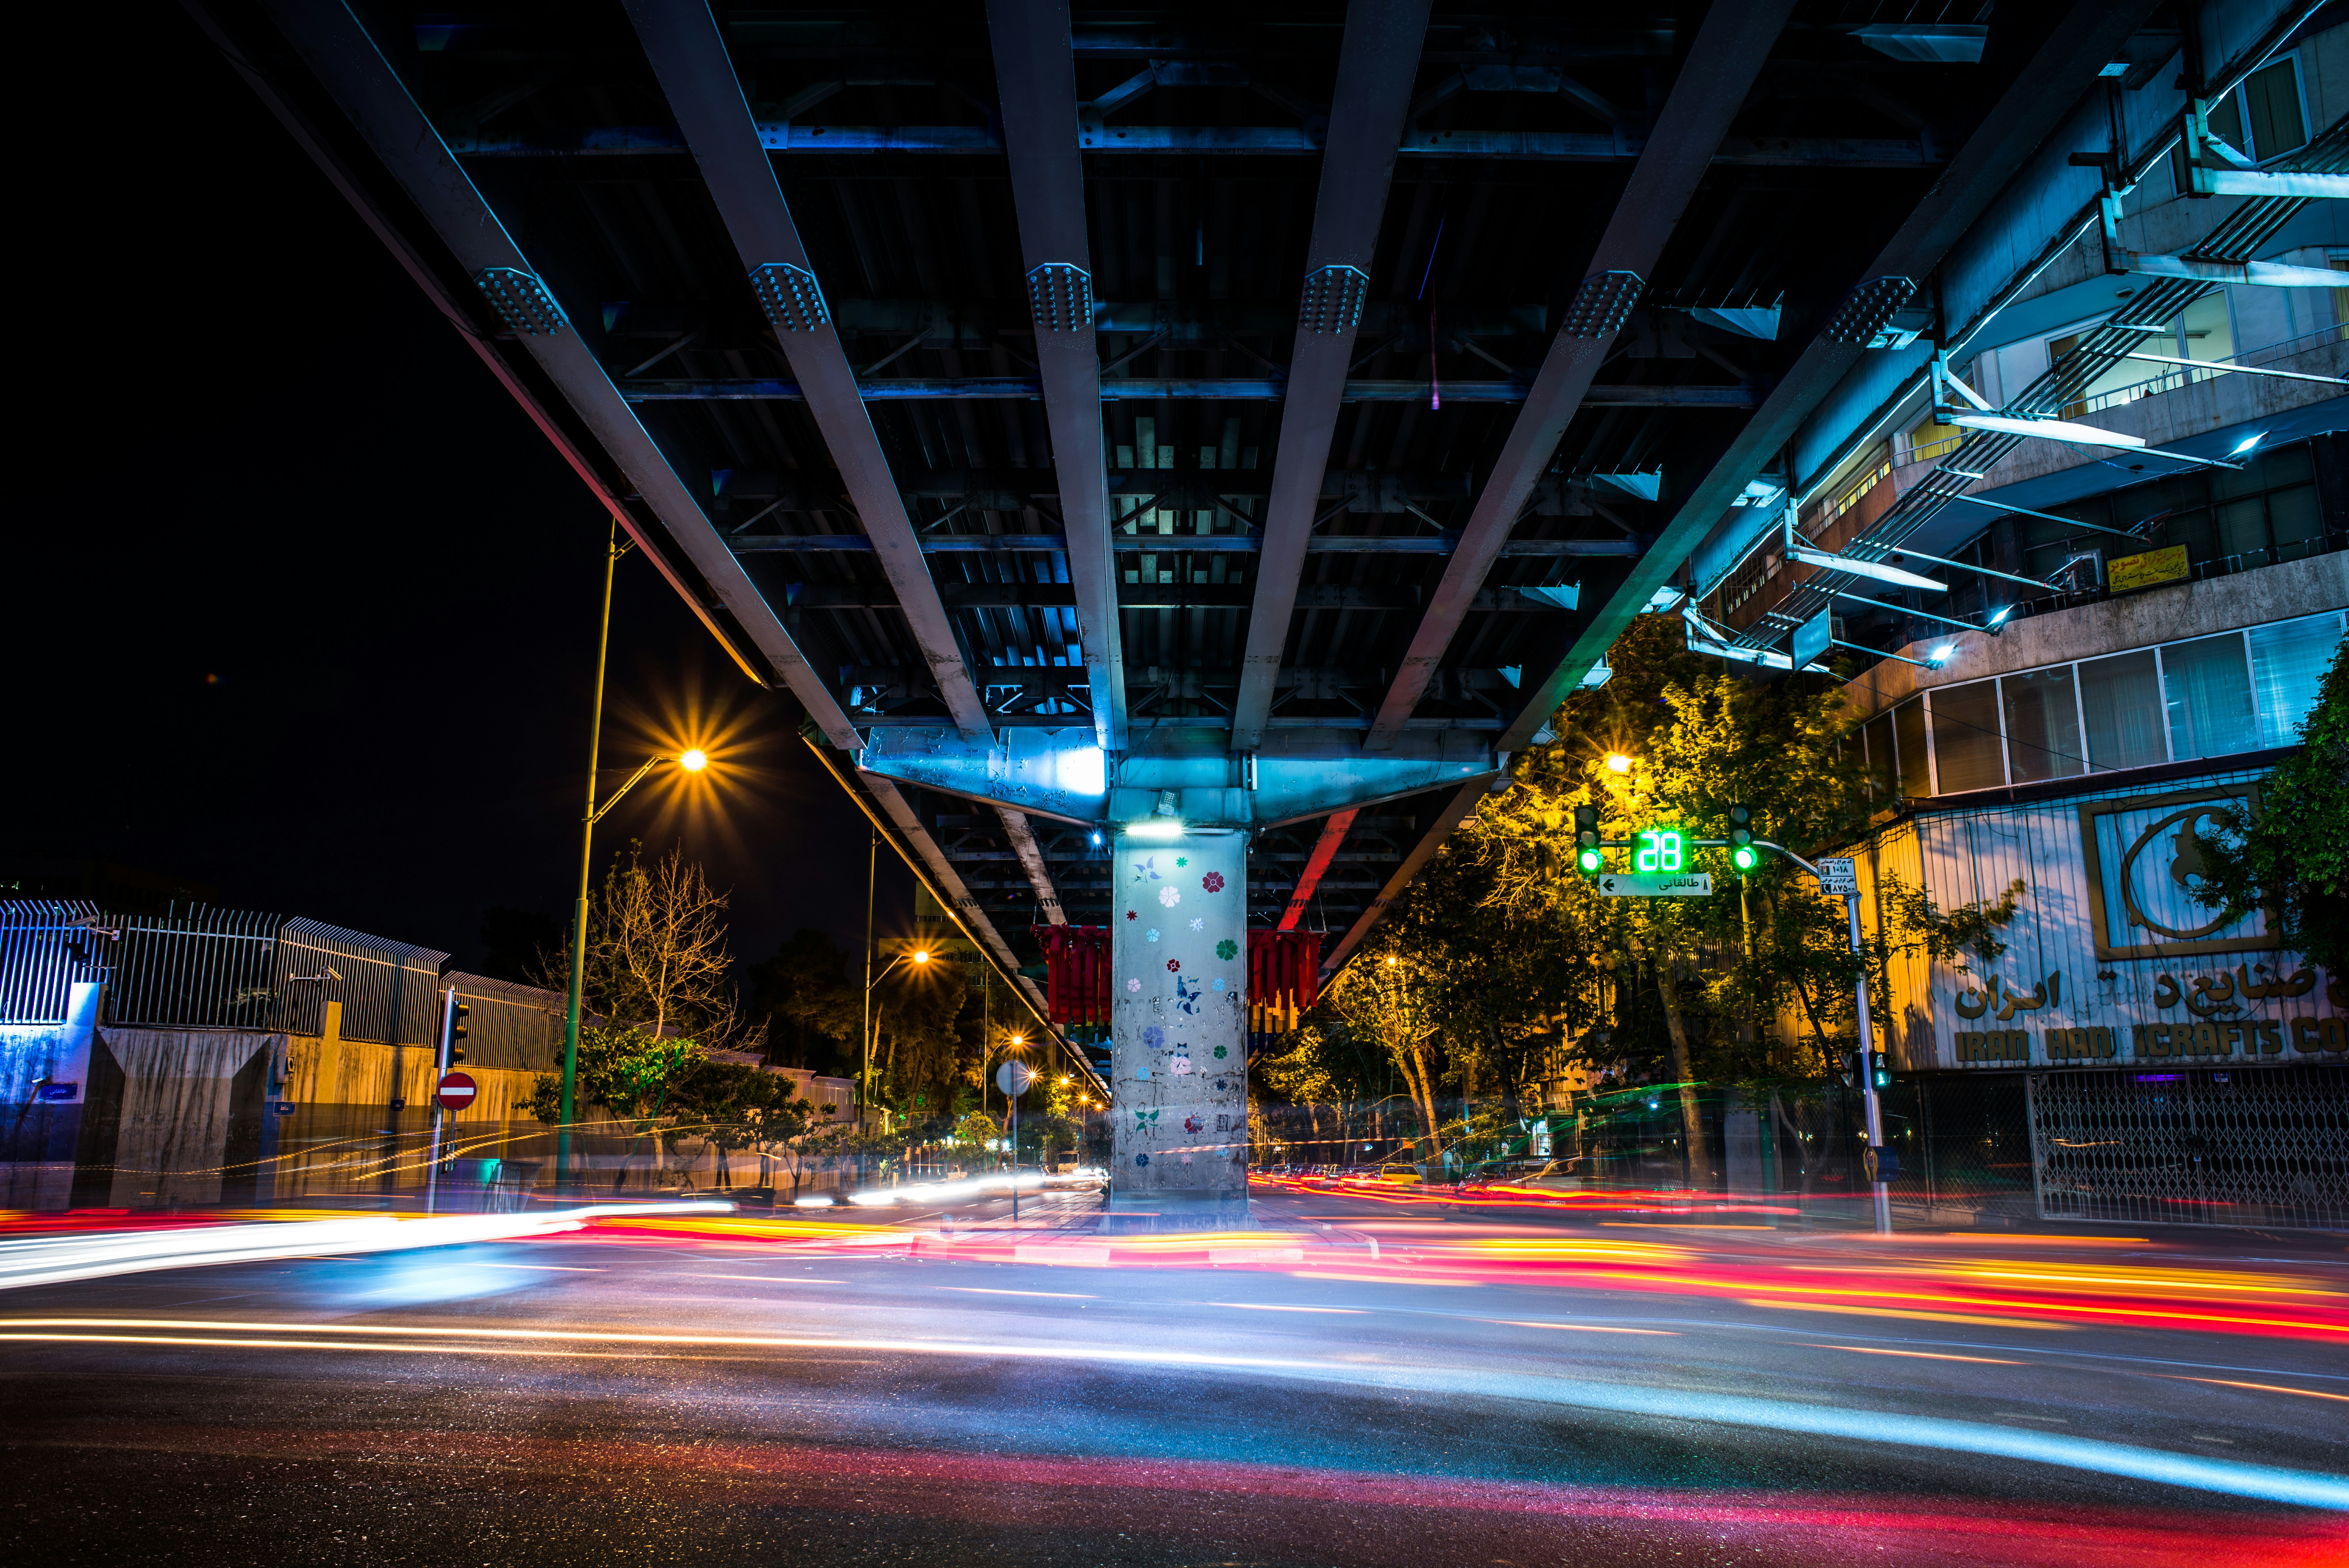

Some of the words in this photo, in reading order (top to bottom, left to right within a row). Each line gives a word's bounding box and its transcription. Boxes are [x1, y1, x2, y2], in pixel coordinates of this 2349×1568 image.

[2110, 555, 2139, 574] تصویر
[1638, 832, 1681, 871] 28
[1659, 878, 1699, 890] طالقانی
[2187, 963, 2316, 1016] صنایع
[1955, 1029, 2030, 1061] IRAN
[2044, 1019, 2281, 1059] HANICRAFTS
